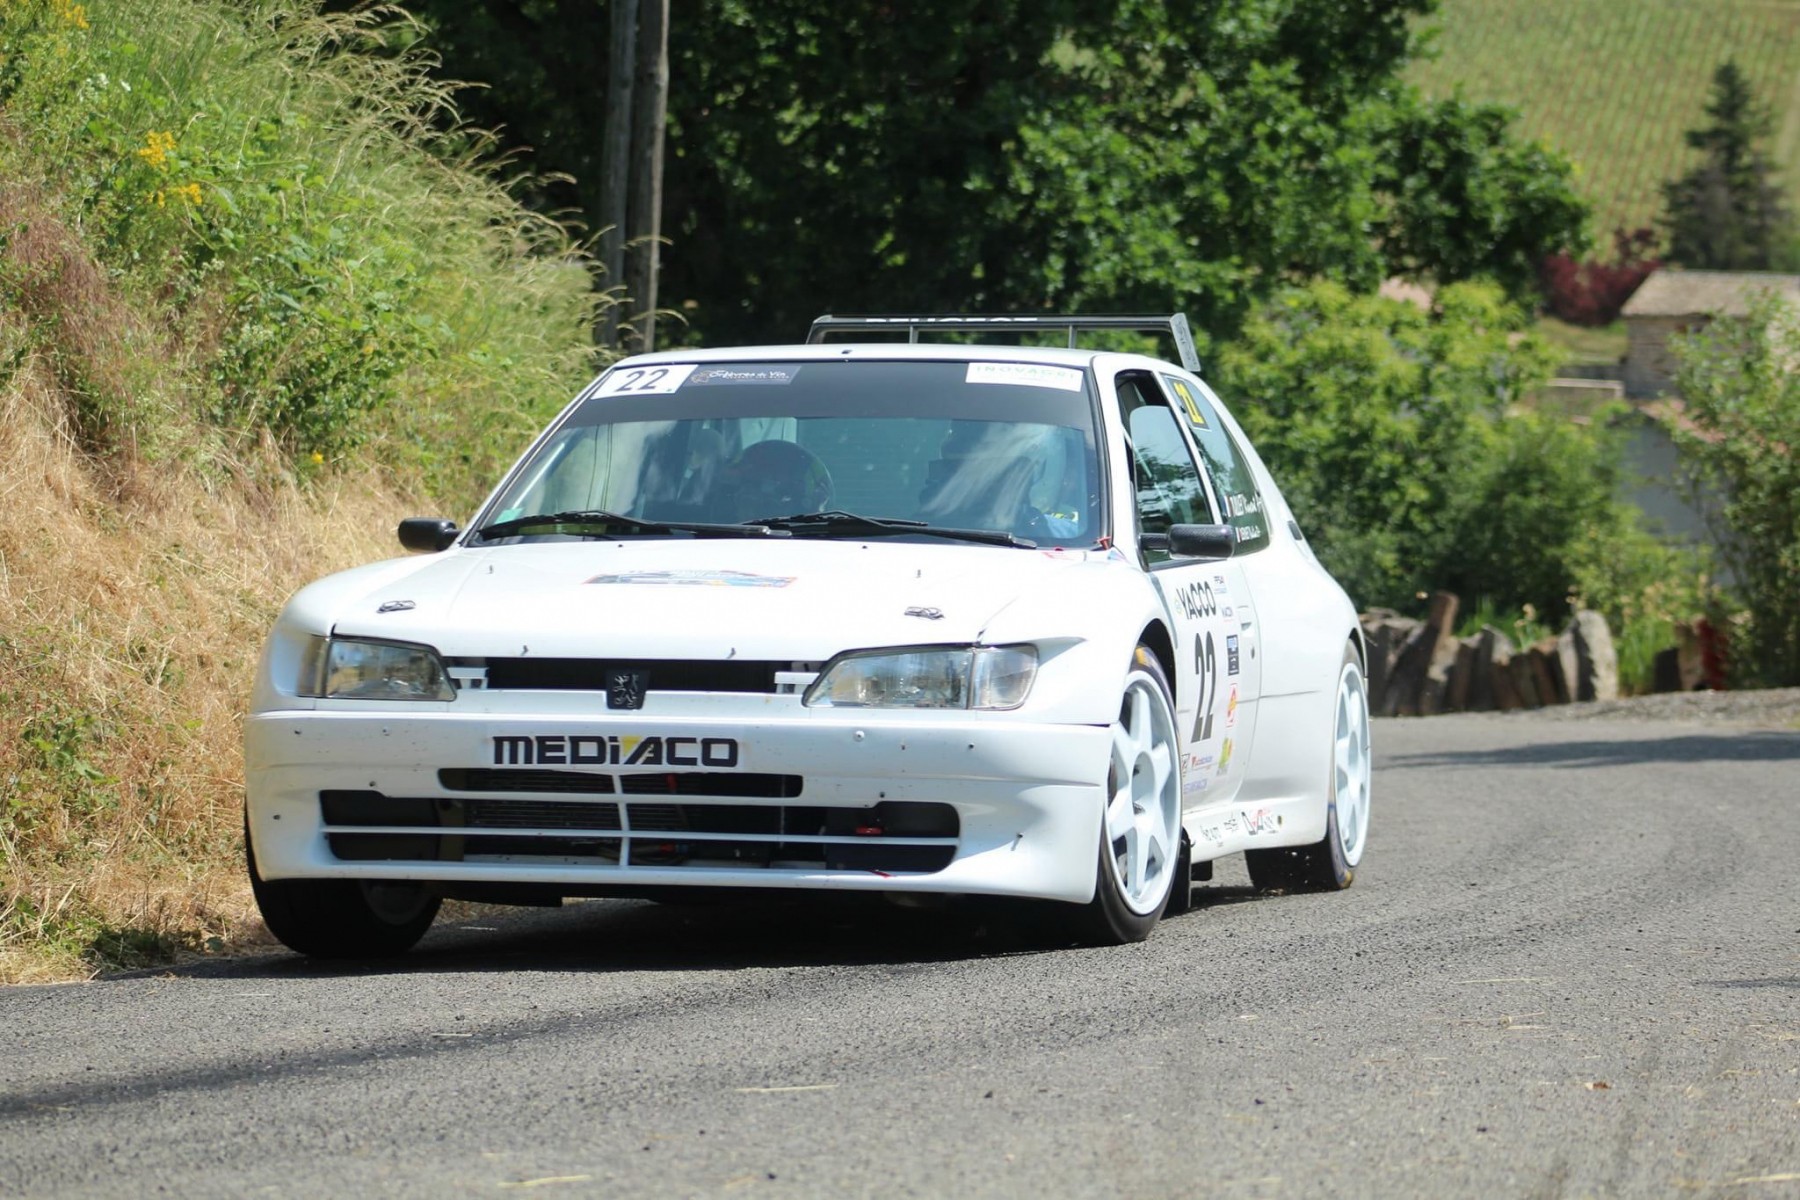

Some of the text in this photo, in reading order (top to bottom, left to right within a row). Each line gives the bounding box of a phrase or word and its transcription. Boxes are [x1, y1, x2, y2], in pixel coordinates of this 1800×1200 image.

[614, 368, 669, 392] 22
[1176, 581, 1216, 619] YACCO
[1190, 631, 1216, 744] 22
